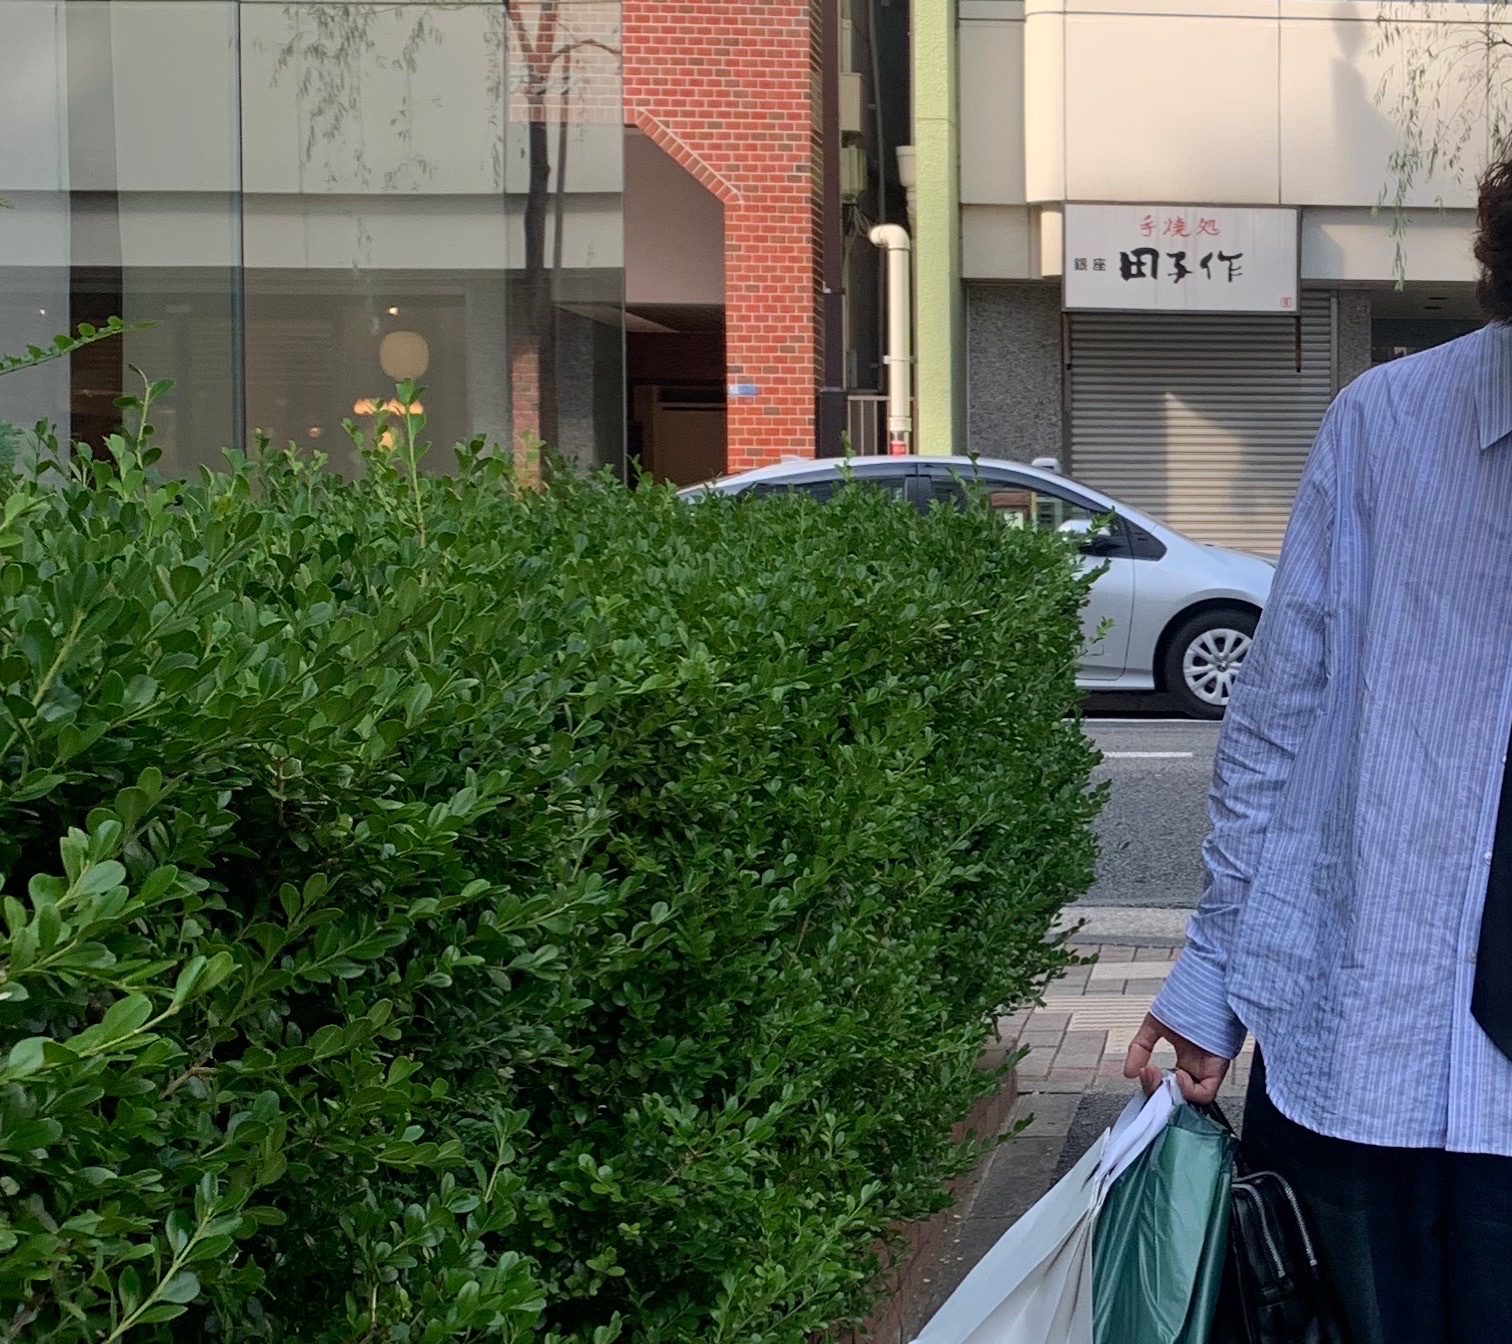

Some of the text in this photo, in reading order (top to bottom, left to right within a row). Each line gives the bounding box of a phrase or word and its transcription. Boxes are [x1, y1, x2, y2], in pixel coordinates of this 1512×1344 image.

[1074, 247, 1244, 284] 銀座 田子作
